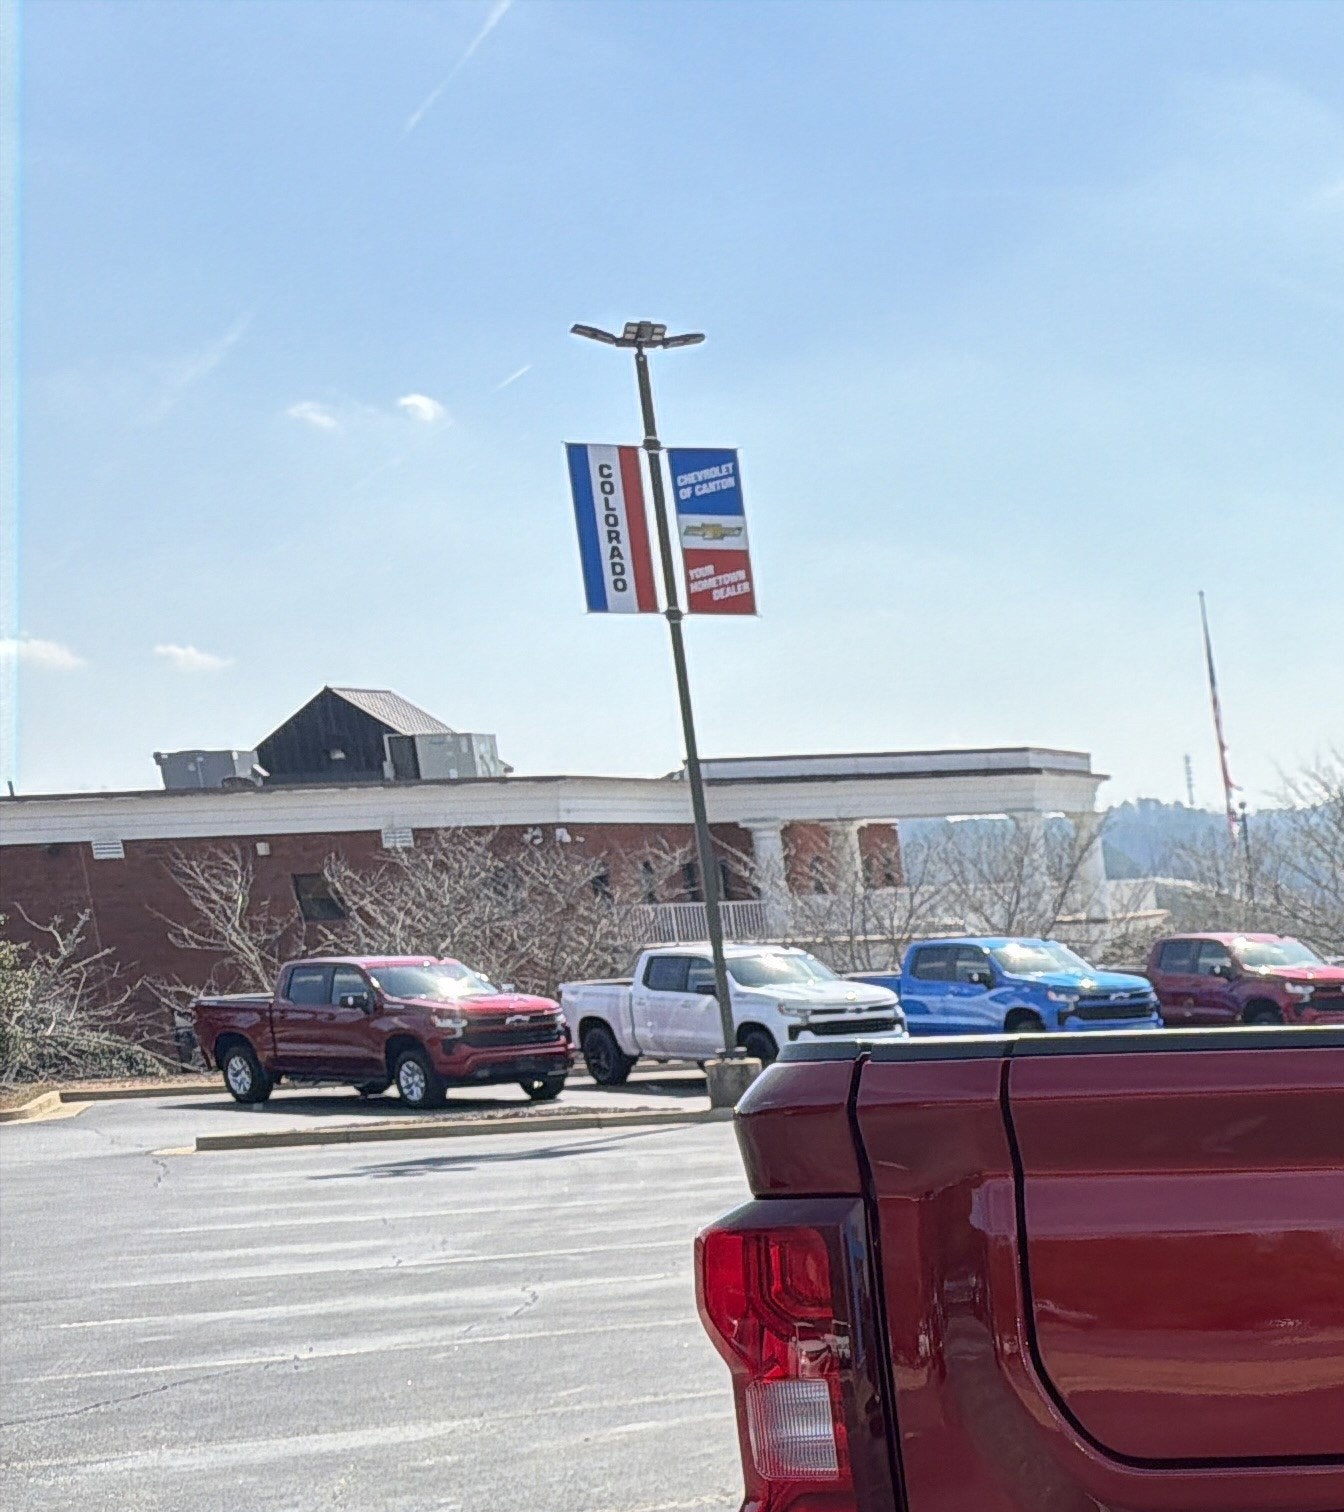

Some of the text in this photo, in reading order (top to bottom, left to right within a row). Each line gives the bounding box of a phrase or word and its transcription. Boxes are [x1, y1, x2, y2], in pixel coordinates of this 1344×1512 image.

[677, 462, 734, 487] CHEVROLET
[679, 476, 736, 500] OF CANTON
[598, 464, 628, 592] COLORADO
